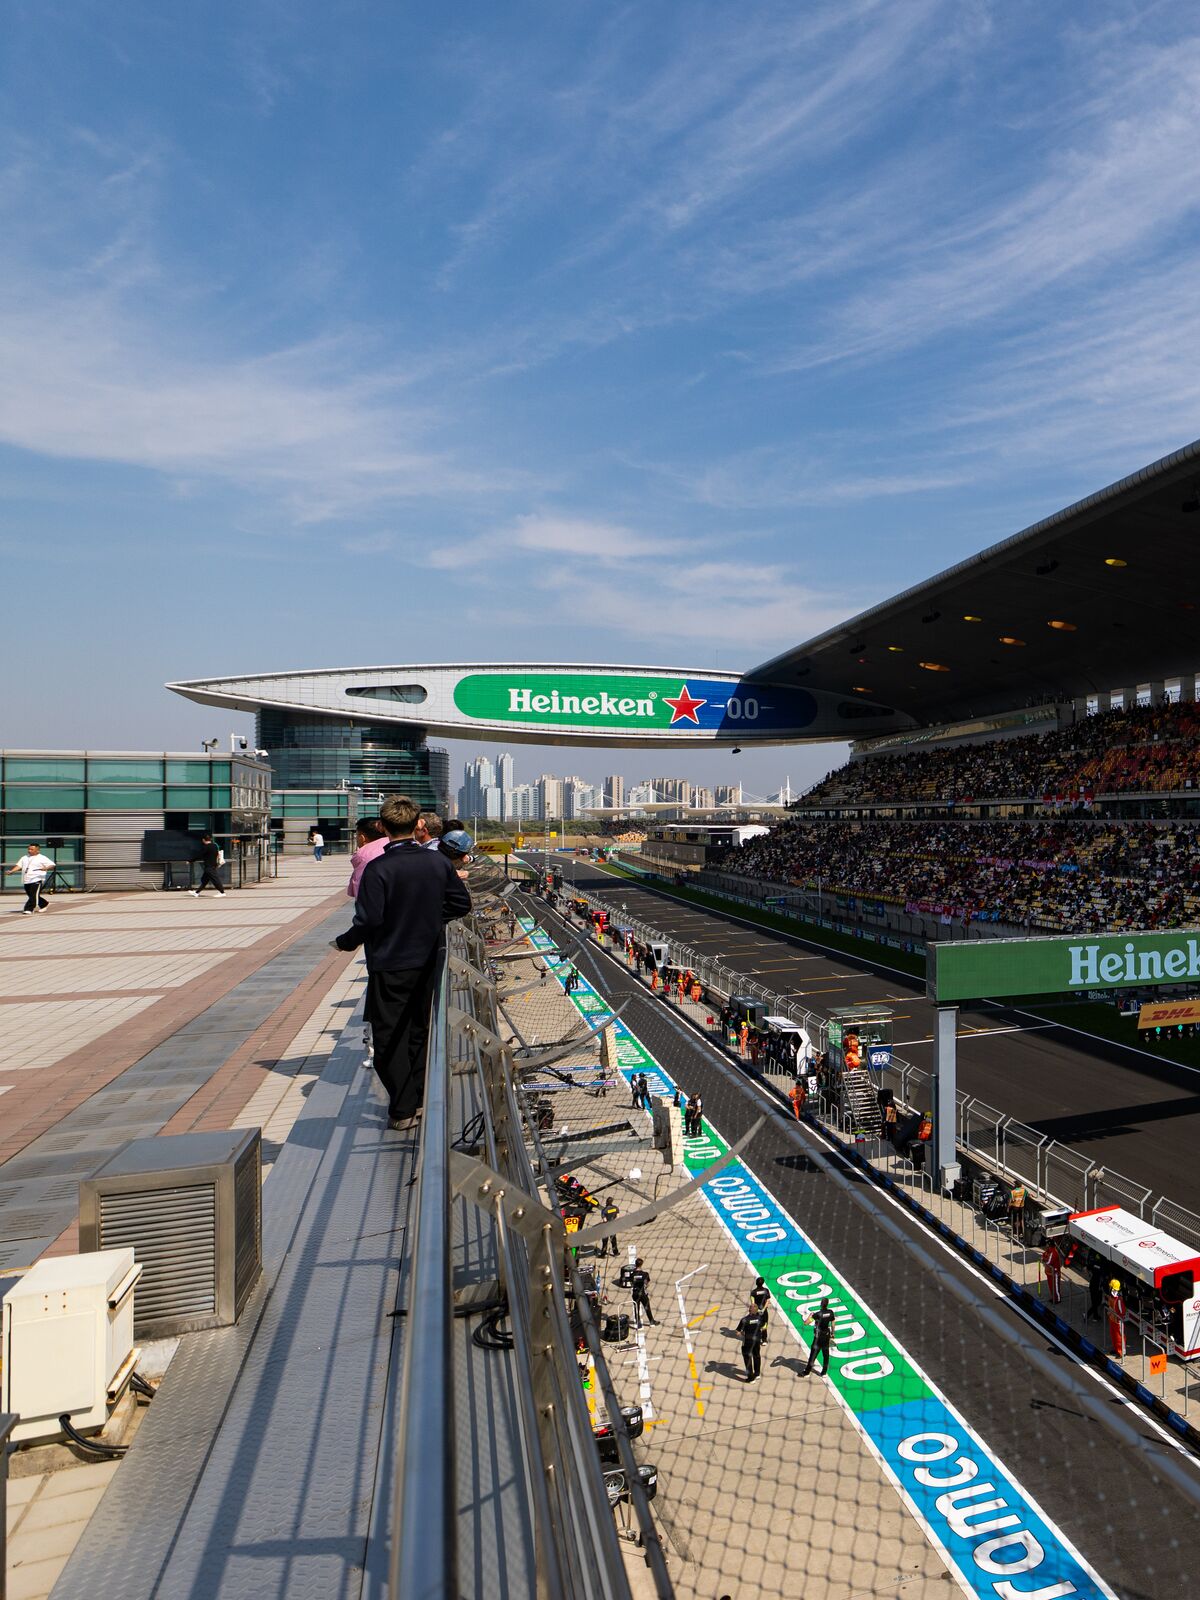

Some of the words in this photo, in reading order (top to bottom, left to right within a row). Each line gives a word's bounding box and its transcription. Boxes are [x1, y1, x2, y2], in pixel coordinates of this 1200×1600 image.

[508, 688, 655, 717] Heineken
[1151, 1007, 1195, 1022] DHL
[708, 1177, 787, 1242] aramco
[897, 1432, 1080, 1600] ramco
